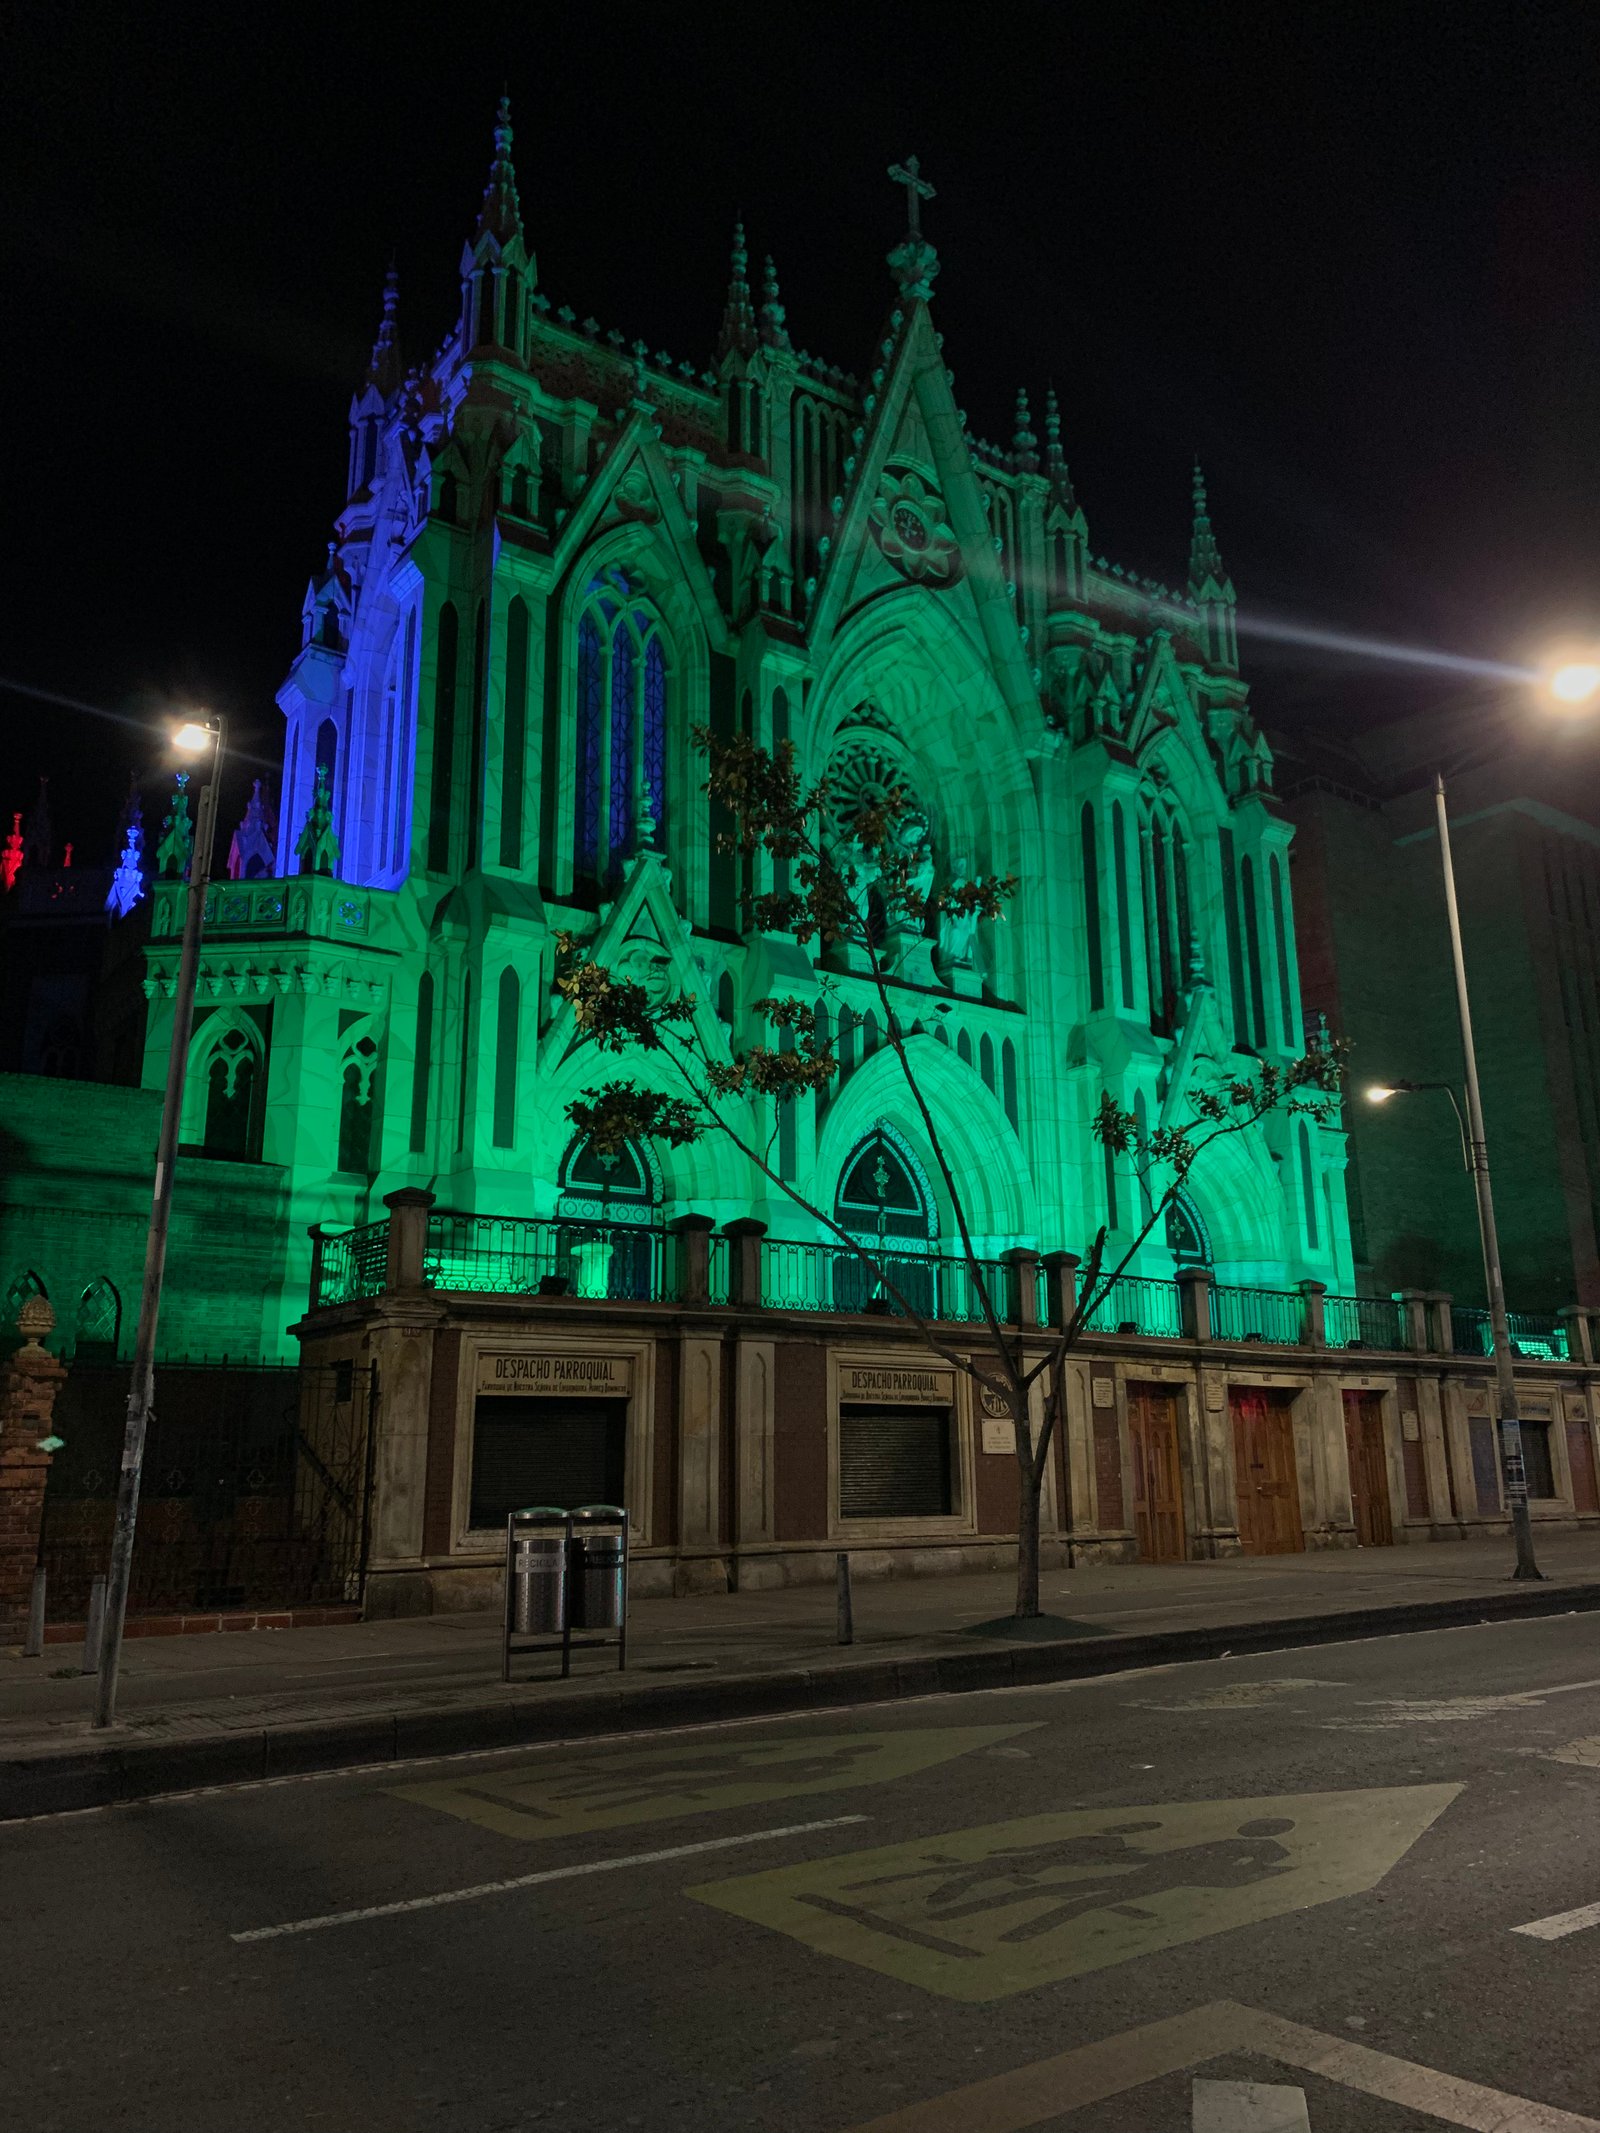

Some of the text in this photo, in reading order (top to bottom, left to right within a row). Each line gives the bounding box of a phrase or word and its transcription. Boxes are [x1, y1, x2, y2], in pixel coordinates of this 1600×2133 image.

[496, 1358, 615, 1381] DESPACHO PARROQUIAL
[852, 1371, 939, 1391] DESPACHO PARROQUIAL
